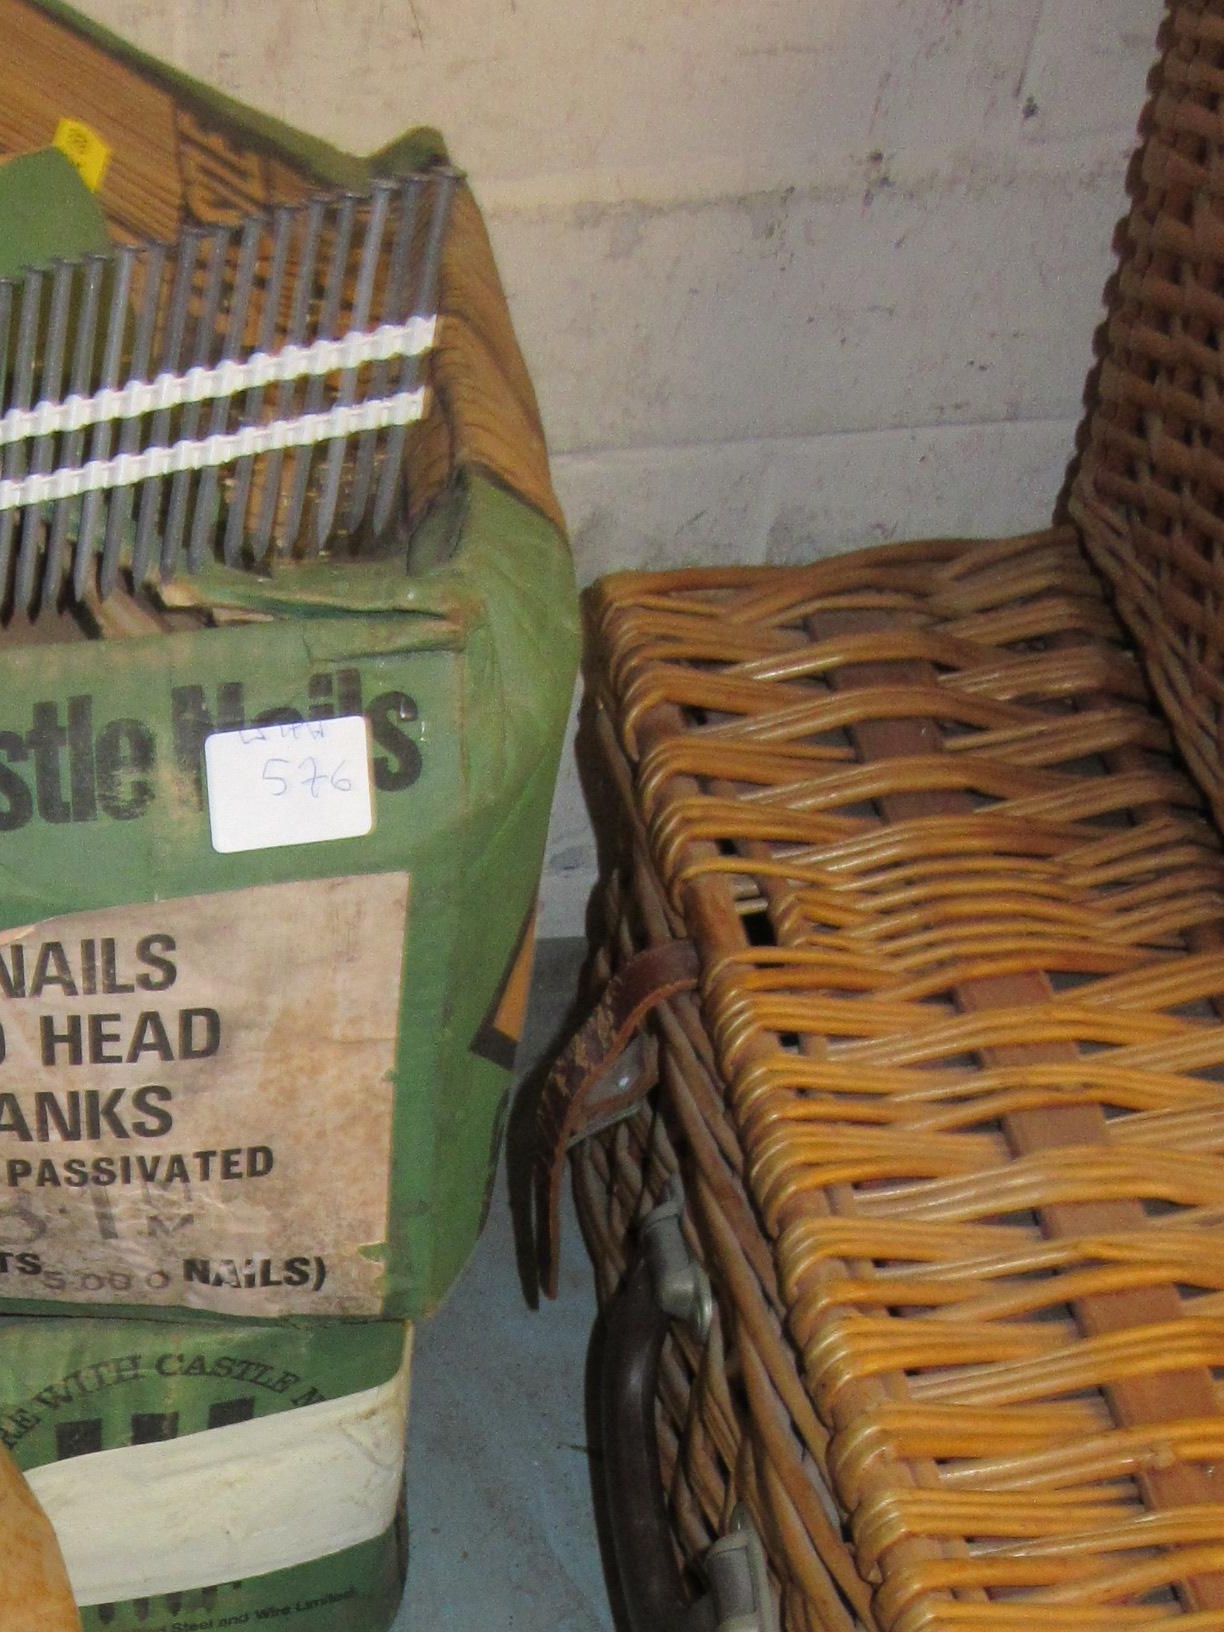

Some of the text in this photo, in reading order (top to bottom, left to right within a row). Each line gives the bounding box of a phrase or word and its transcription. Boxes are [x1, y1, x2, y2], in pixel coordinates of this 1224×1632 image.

[262, 756, 352, 799] 576
[39, 1007, 222, 1067] HEAD
[6, 1144, 274, 1188] PASSIVATED
[33, 1353, 143, 1410] WITH
[154, 1352, 302, 1394] CASTLE
[217, 1613, 251, 1630] and
[254, 1605, 291, 1621] Wire
